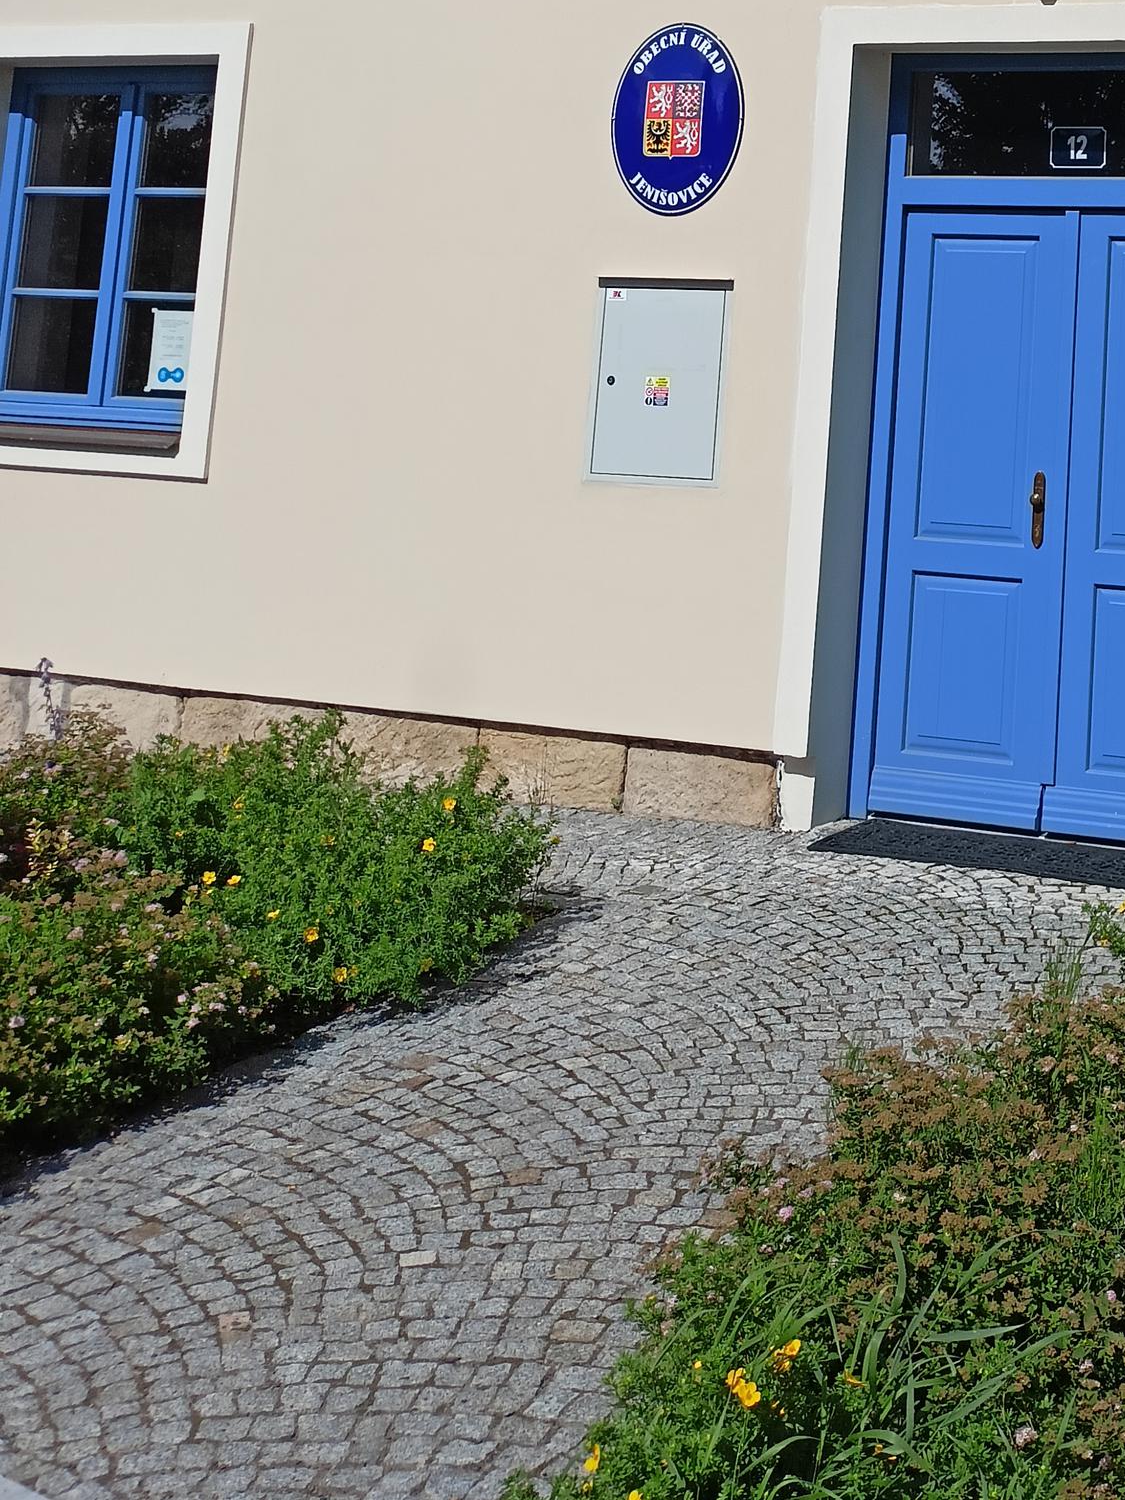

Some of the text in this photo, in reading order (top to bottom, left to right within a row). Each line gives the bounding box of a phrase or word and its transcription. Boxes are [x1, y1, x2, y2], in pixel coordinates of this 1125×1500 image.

[633, 29, 726, 75] OBECNÍ ÚŘAD
[1067, 134, 1088, 160] 12
[629, 172, 713, 206] JENIŠOVICE
